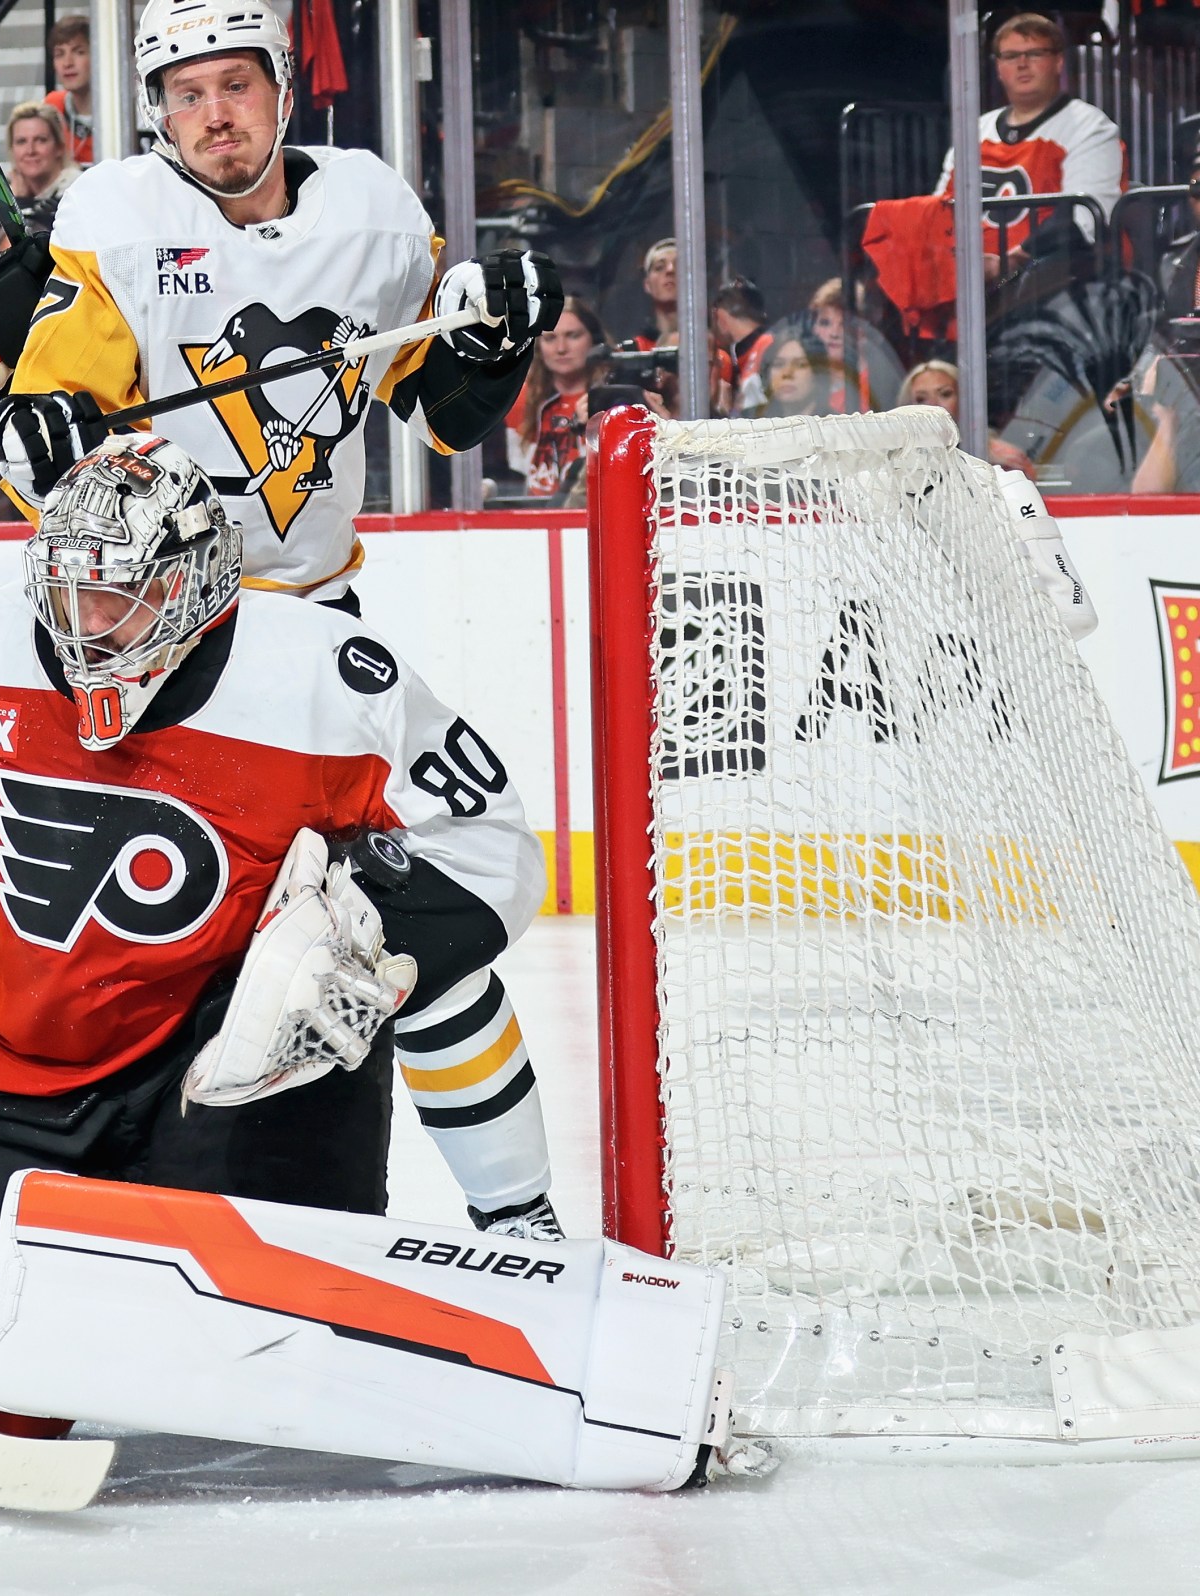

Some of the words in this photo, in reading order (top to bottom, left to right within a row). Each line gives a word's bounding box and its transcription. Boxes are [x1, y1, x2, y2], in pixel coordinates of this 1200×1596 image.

[166, 15, 216, 36] CCM
[158, 272, 214, 296] F.N.B.
[346, 645, 392, 684] 1
[409, 716, 508, 817] 80
[385, 1237, 565, 1284] BAUER
[622, 1272, 680, 1289] SHADOW
